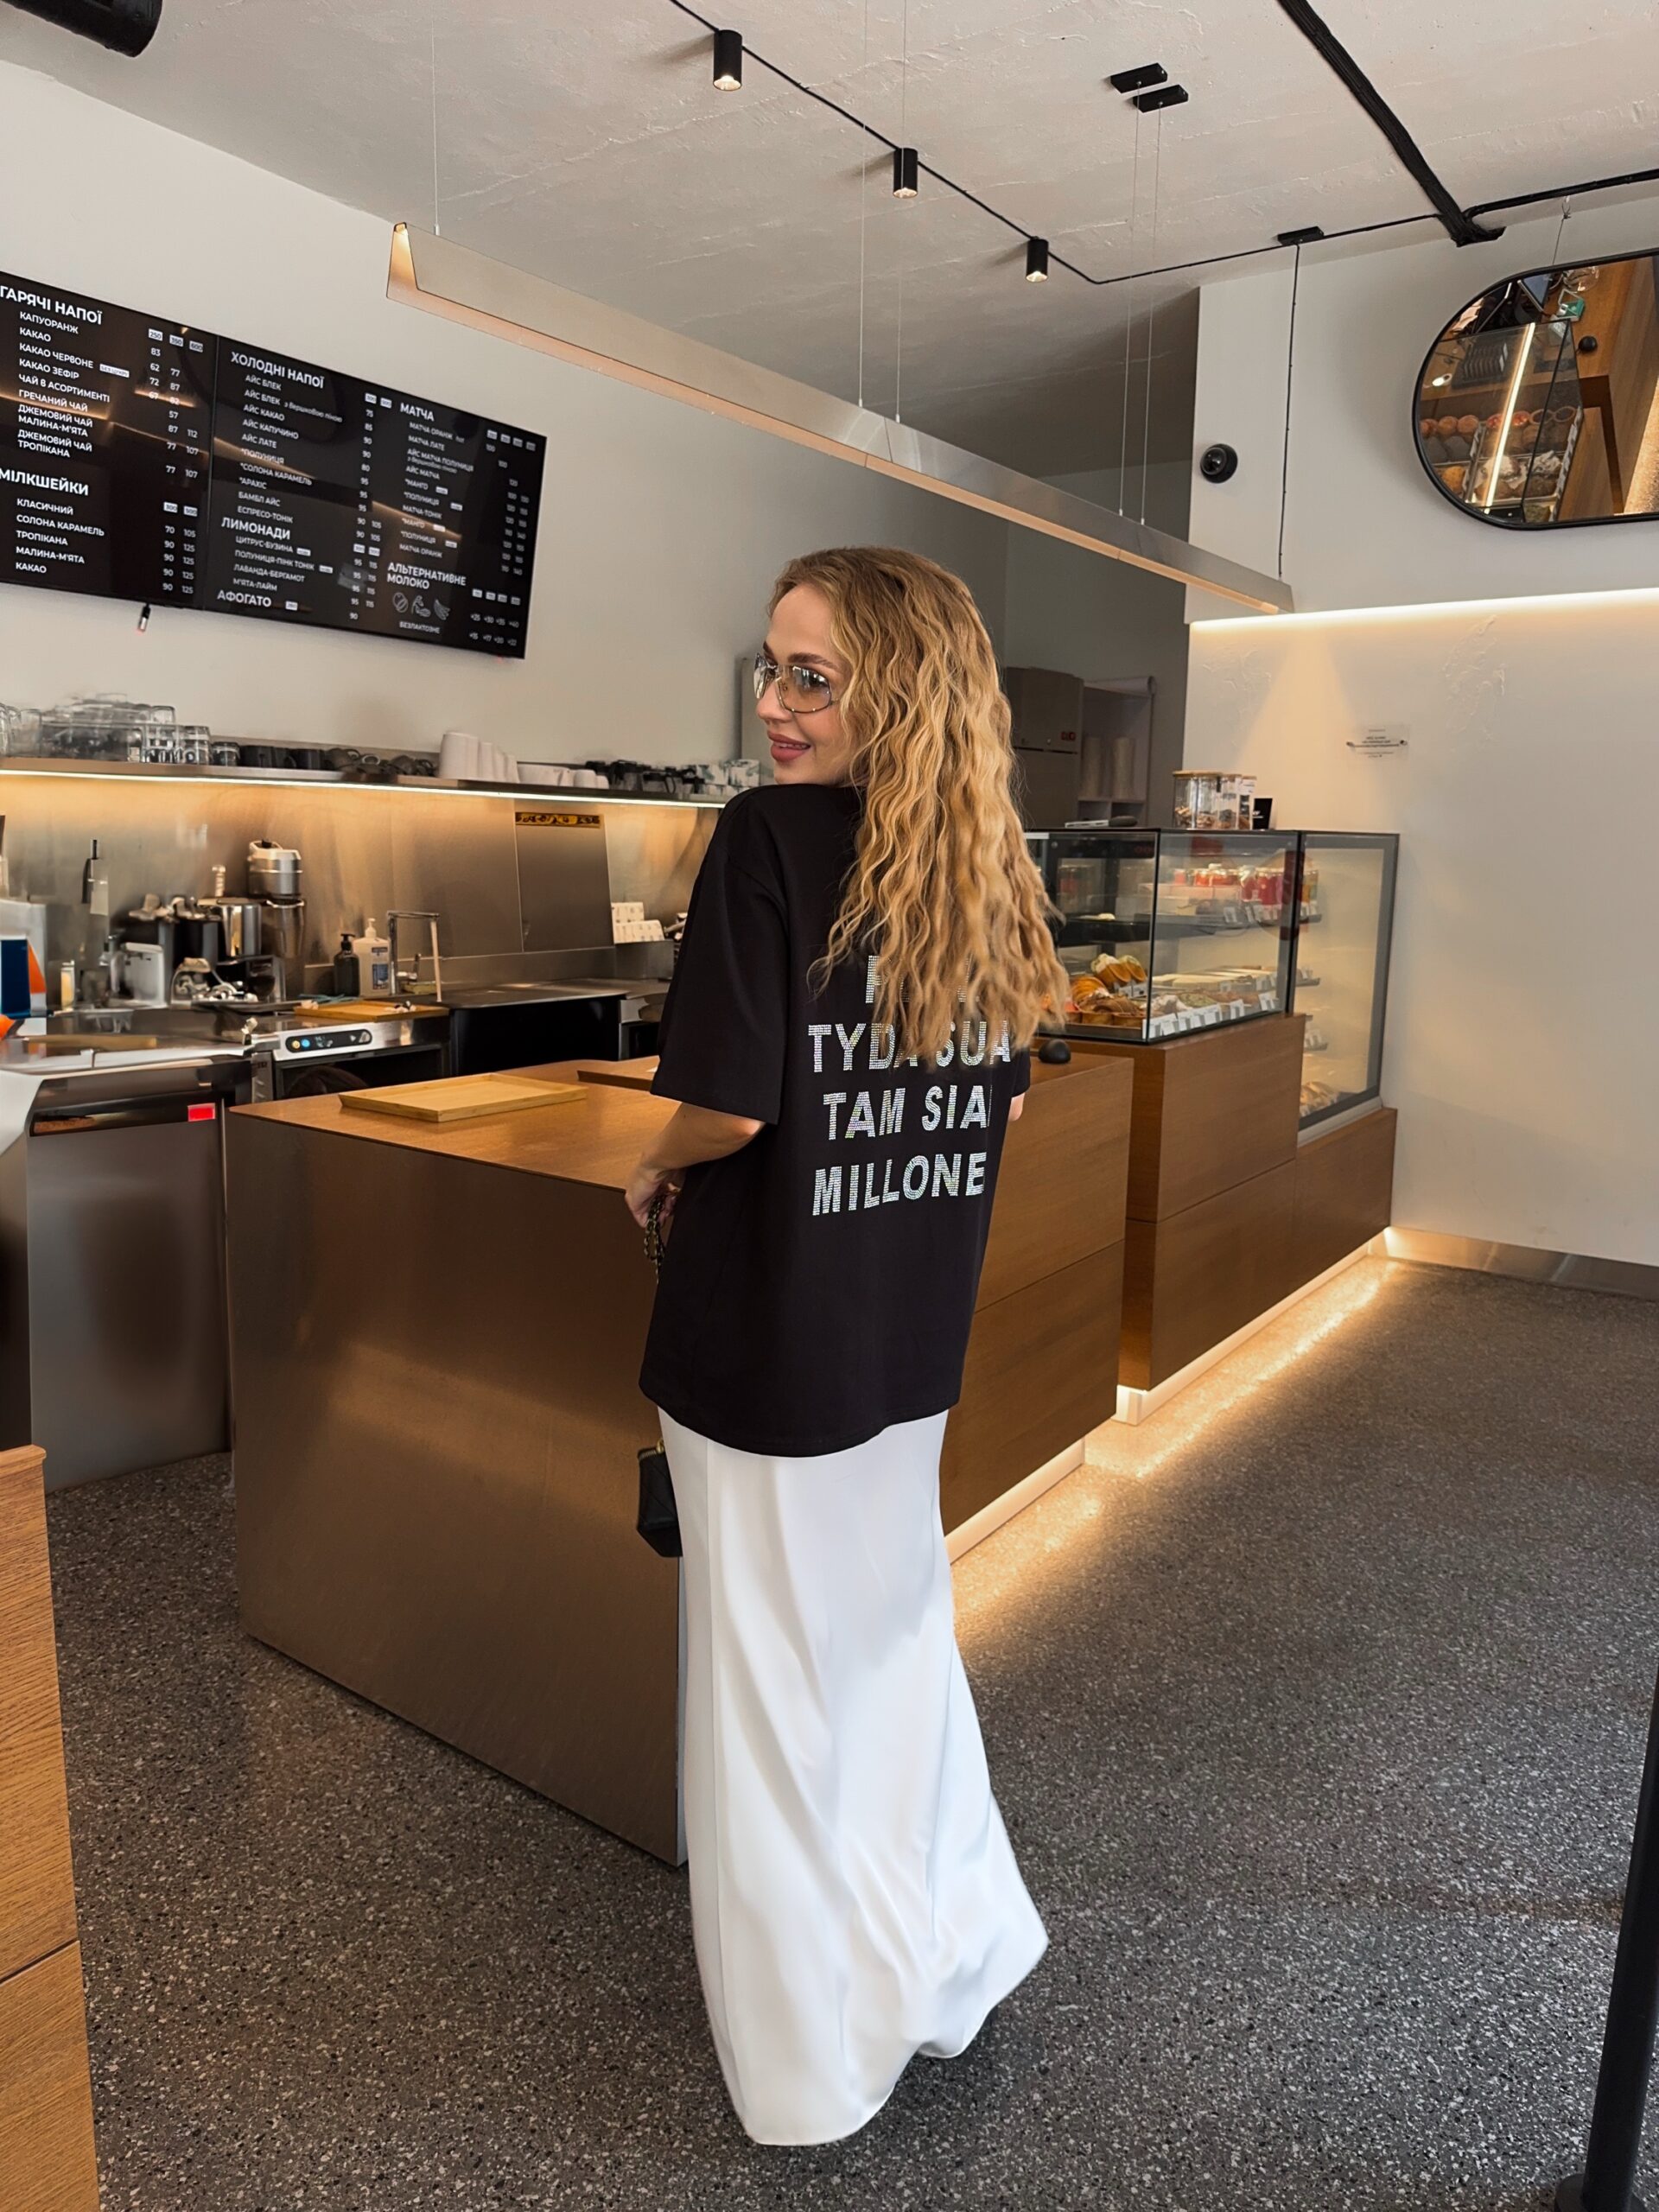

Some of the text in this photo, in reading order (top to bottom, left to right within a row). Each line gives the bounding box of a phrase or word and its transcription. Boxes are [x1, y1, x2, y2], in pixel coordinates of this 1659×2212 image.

[0, 286, 102, 324] ГАРЯЧІ НАПОЇ
[20, 312, 78, 334] КАПУОРАНЖ
[20, 327, 51, 341] КАКАО
[150, 331, 162, 340] 250
[20, 343, 50, 357] КАКАО
[53, 352, 93, 368] ЧЕРВОНЕ
[151, 347, 161, 356] 83
[20, 359, 79, 378] КАКАО ЗЕФІР
[150, 363, 180, 377] 62 77
[232, 352, 324, 388] ХОЛОДНІ НАПОЇ
[19, 374, 38, 385] ЧАЙ
[48, 382, 110, 403] АСОРТИМЕНТІ
[149, 377, 159, 386] 72
[245, 375, 281, 391] АЙС БЛЕК
[19, 388, 88, 412] ГРЕЧАНИЙ ЧАЙ
[245, 390, 260, 399] АЙС
[262, 394, 280, 405] БЛЕК
[18, 403, 92, 427] ДЖЕМОВИЙ ЧАЙ
[244, 404, 284, 421] АЙС КАКАО
[400, 403, 434, 421] МАТЧА
[19, 415, 87, 436] МАЛИНА-М'ЯТА
[188, 429, 197, 438] 112
[243, 419, 298, 439] АЙС КАПУЧИНО
[410, 423, 429, 433] МАТЧА
[18, 429, 92, 451] ДЖЕМОВИЙ ЧАЙ
[242, 434, 276, 448] АЙС ЛАТЕ
[409, 435, 444, 451] МАТЧА ЛАТЕ
[18, 440, 70, 457] ТРОПІКАНА
[167, 442, 199, 456] 77 107
[408, 448, 420, 457] АЙС
[422, 453, 441, 462] МАТЧА
[186, 469, 198, 478] 107
[275, 471, 312, 485] КАРАМЕЛЬ
[406, 466, 440, 479] АЙС МАТЧА
[0, 468, 88, 495] МІЛКШЕЙКИ
[17, 499, 73, 515] КЛАСИЧНИЙ
[238, 492, 280, 506] БАМБЛ АЙС
[238, 505, 293, 523] ЕСПРЕСО-ТОНІК
[16, 514, 104, 536] СОЛОНА КАРАМЕЛЬ
[184, 529, 195, 537] 105
[221, 518, 290, 540] ЛИМОНАДИ
[16, 531, 67, 545] ТРОПІКАНА
[236, 536, 293, 552] ЦИТРУС-БУЗИНА
[16, 546, 84, 563] МАЛИНА-М'ЯТА
[184, 543, 194, 552] 125
[399, 543, 420, 552] МАТЧА
[16, 563, 47, 573] КАКАО
[183, 556, 194, 565] 125
[235, 550, 293, 566] ПОЛУНИЦЯ-ПІНК
[295, 561, 314, 570] ТОНІК
[182, 571, 194, 580] 125
[234, 564, 304, 582] ЛАВАНДА-БЕРГАМОТ
[387, 573, 429, 588] МОЛОКО
[388, 563, 466, 585] АЛЬТЕРНАТИВНЕ
[233, 578, 277, 591] М'ЯТА-ЛАЙМ
[218, 590, 271, 607] АФОГАТО
[823, 1084, 992, 1141] TAM SIA
[812, 1151, 987, 1216] MILLONE
